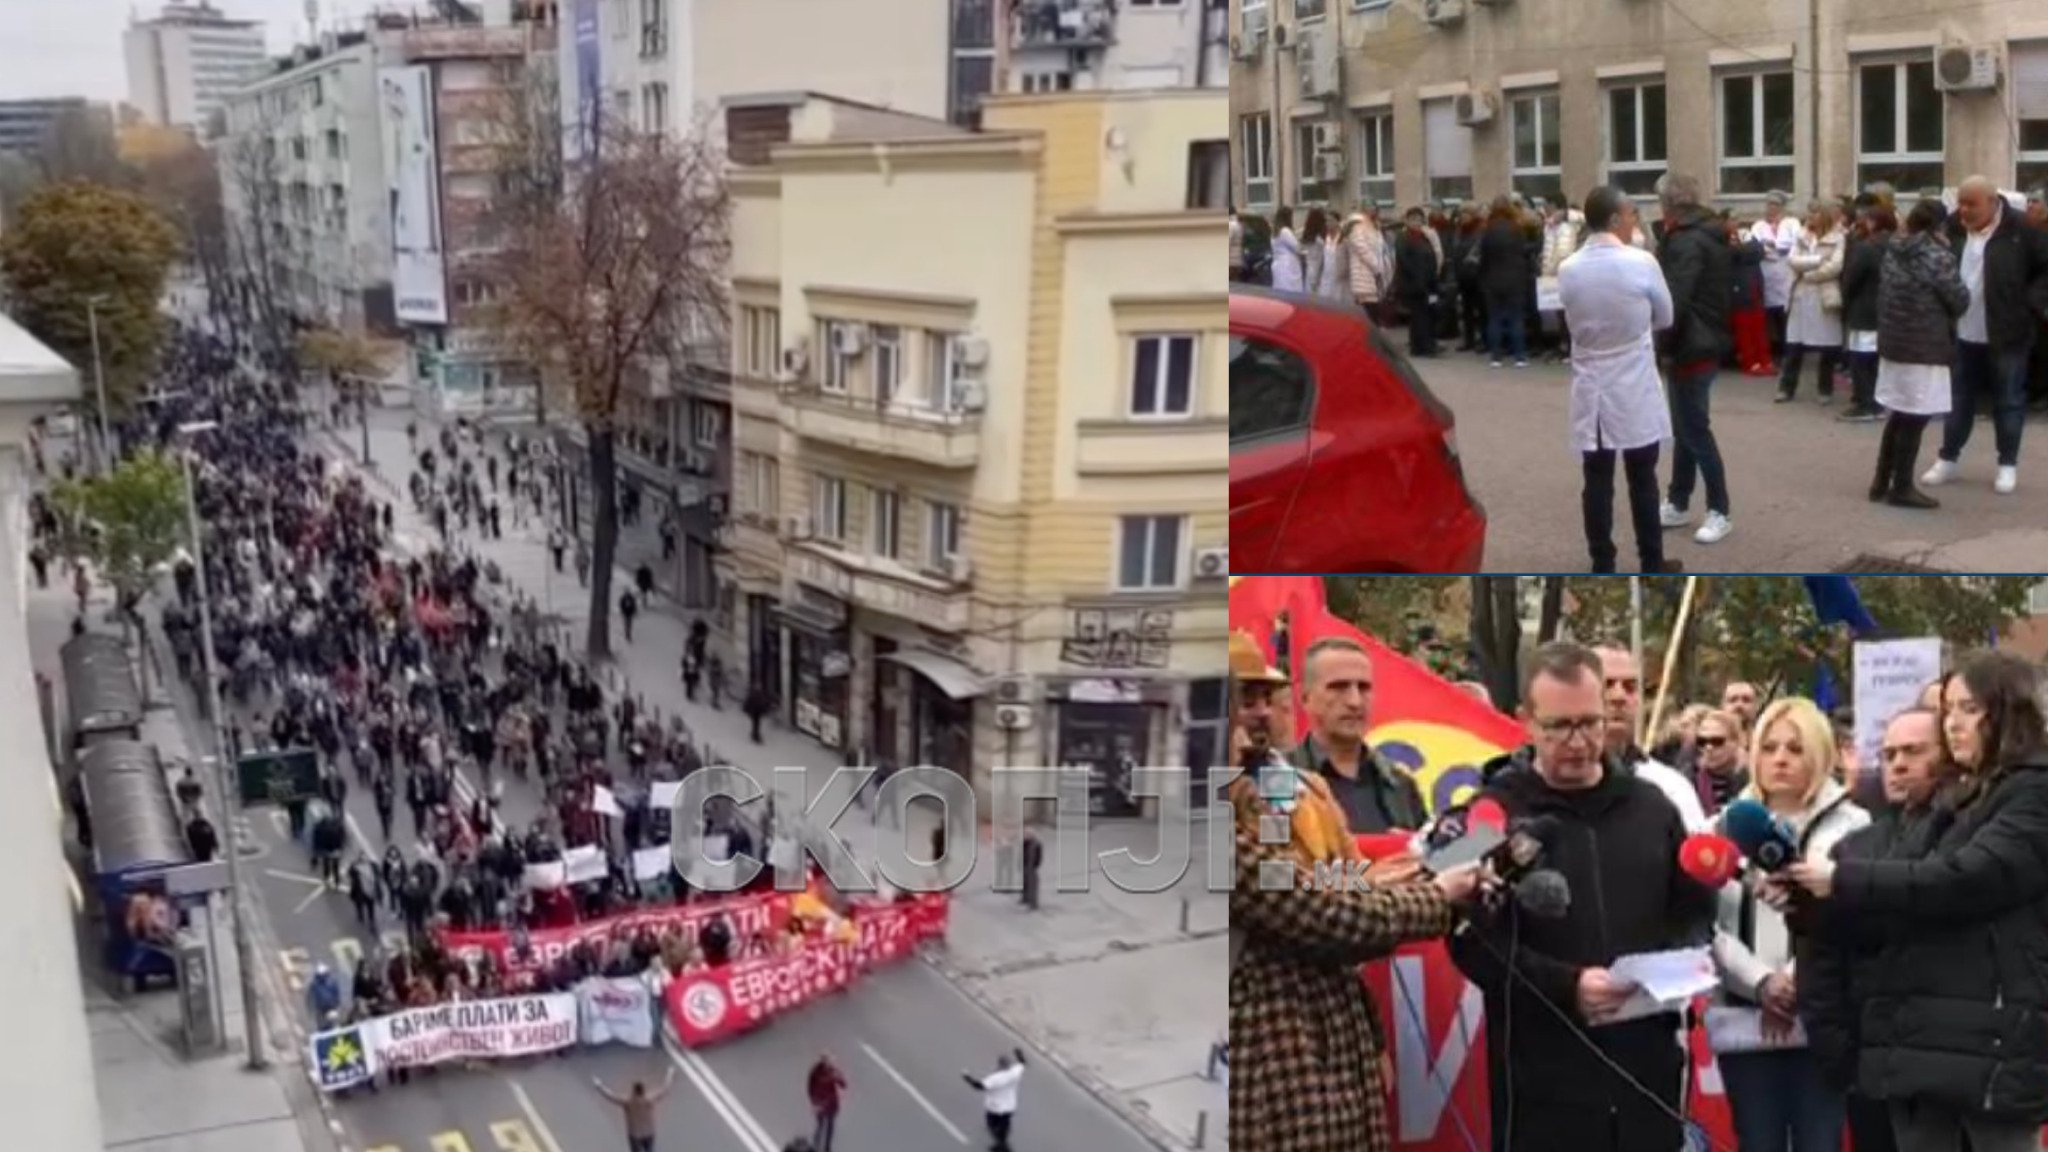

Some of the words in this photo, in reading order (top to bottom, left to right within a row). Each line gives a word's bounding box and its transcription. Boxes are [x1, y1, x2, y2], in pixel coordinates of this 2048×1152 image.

[457, 1002, 520, 1028] ПЛАТИ
[524, 999, 549, 1021] ЗА
[511, 1019, 572, 1046] ЖИВОТ
